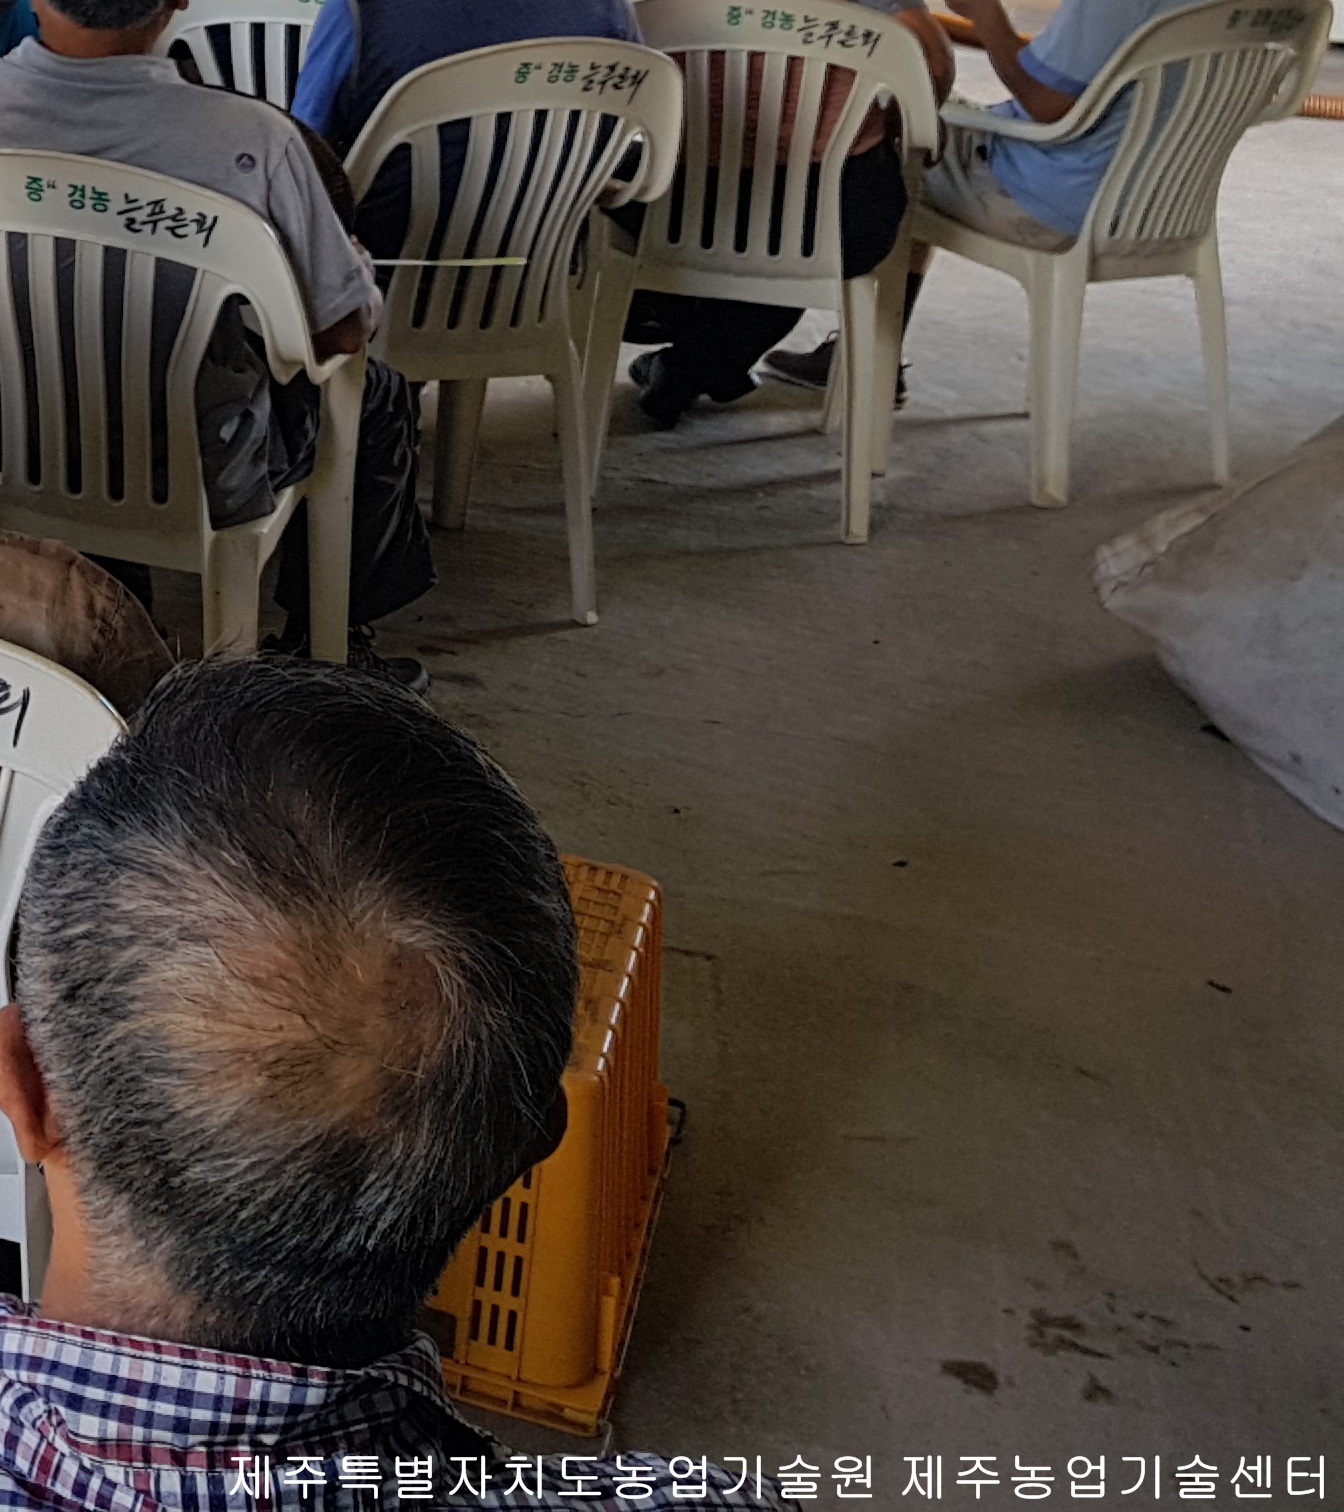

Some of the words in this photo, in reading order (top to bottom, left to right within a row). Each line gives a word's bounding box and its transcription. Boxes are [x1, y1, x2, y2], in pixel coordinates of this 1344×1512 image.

[762, 8, 796, 31] 경농
[546, 61, 581, 85] 경농
[67, 182, 111, 214] 경농
